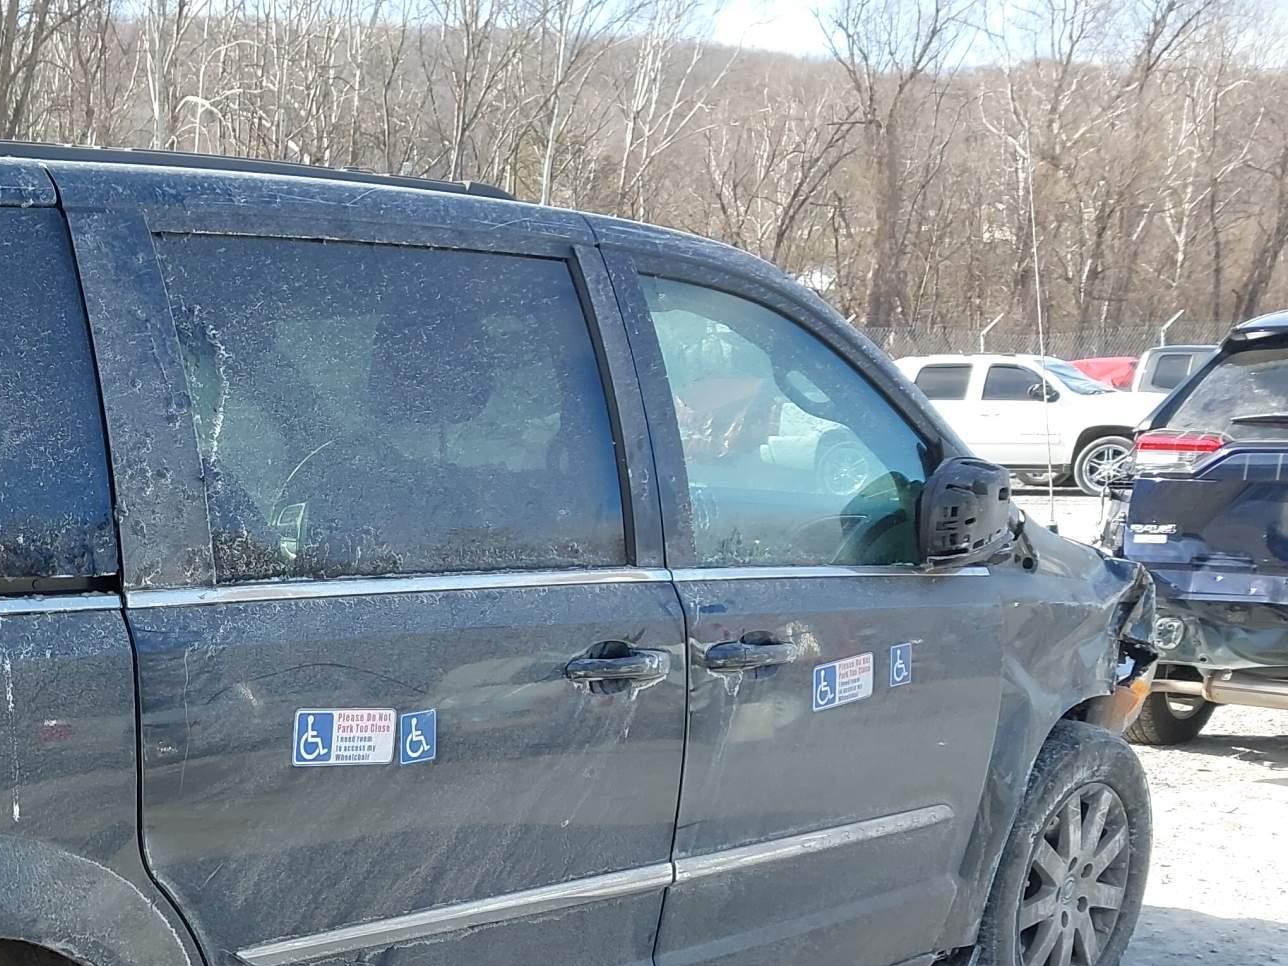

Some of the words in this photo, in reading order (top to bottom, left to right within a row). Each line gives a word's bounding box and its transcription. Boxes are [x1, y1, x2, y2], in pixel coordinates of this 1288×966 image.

[338, 712, 365, 722] Please
[367, 712, 377, 722] Do
[379, 712, 392, 722] Not
[337, 724, 354, 733] Park
[356, 724, 369, 733] Too
[371, 723, 391, 733] Close
